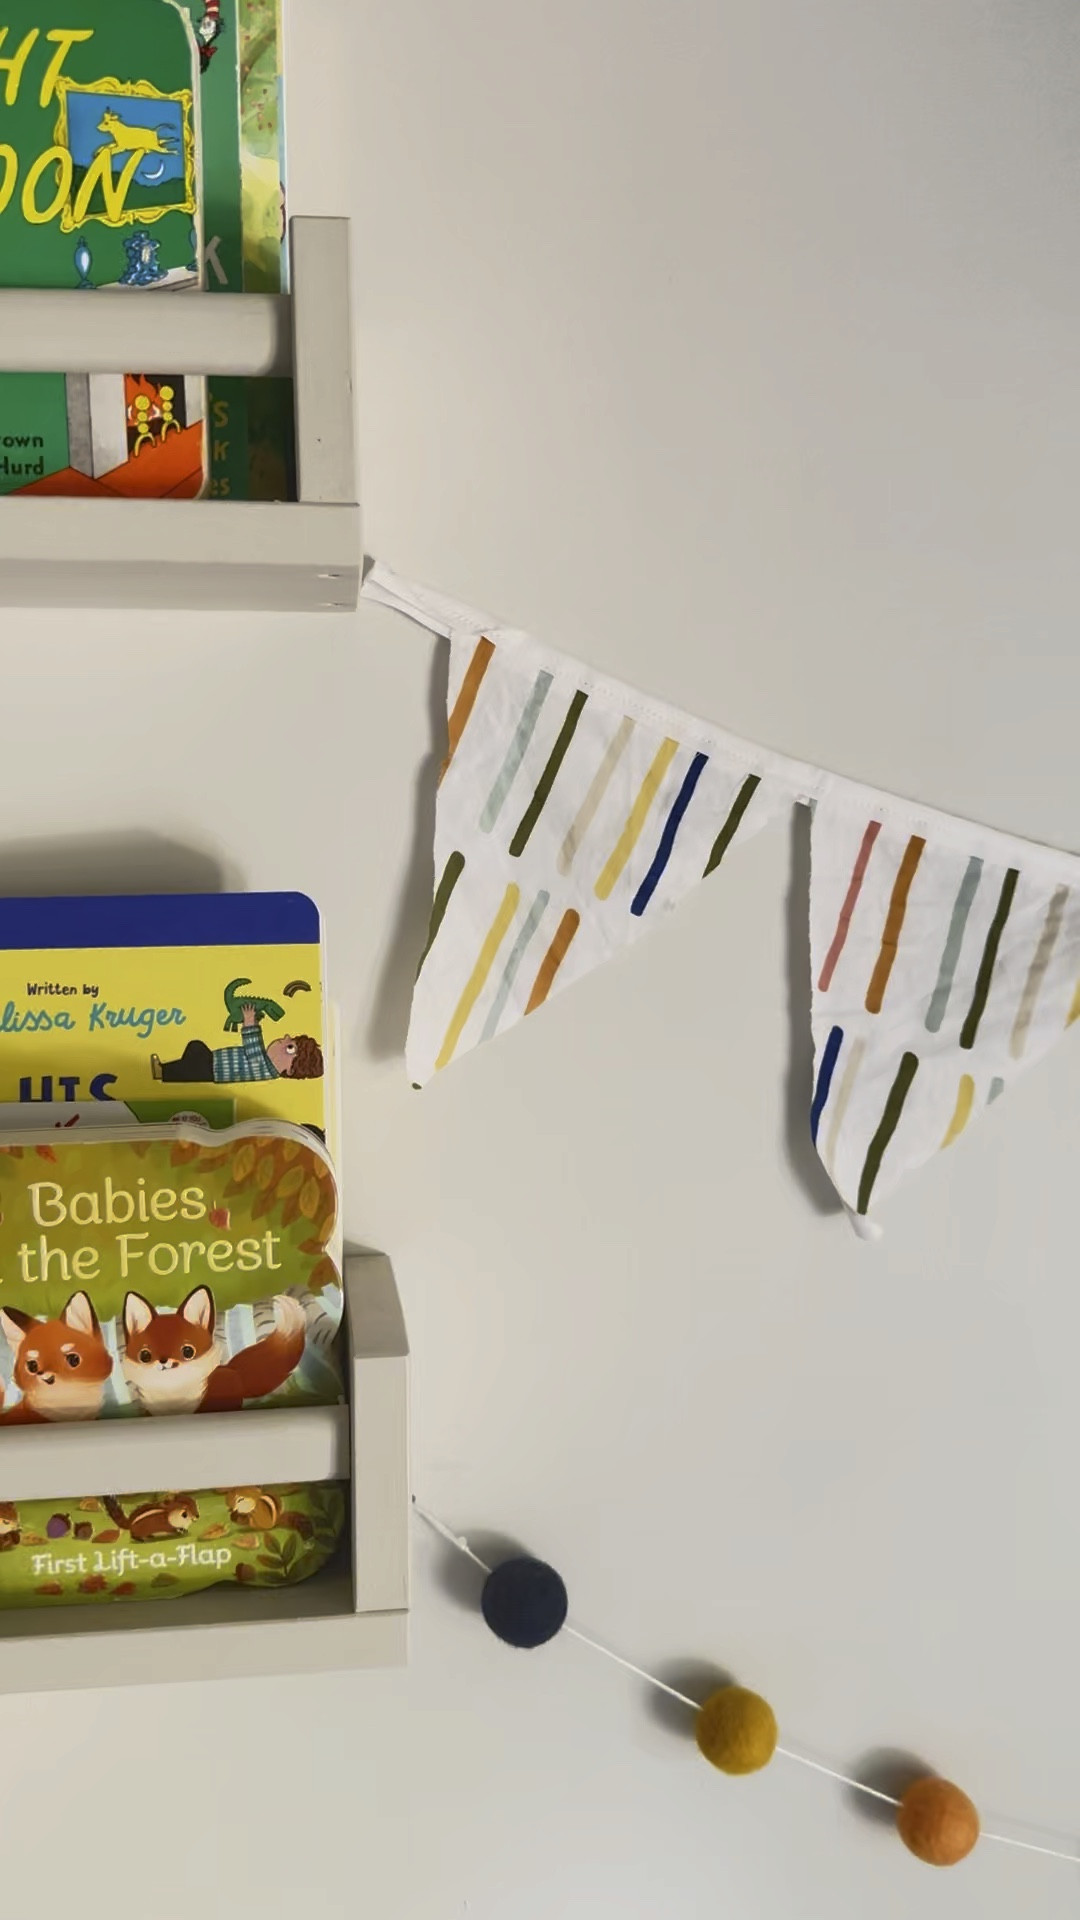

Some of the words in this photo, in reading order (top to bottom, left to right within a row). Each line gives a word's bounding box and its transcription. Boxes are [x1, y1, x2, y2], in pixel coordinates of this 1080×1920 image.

[0, 435, 44, 448] own
[27, 982, 78, 996] Written
[82, 984, 99, 998] by
[0, 1000, 76, 1032] lissa
[89, 1003, 187, 1038] Kruger
[27, 1176, 207, 1227] Babies
[17, 1234, 101, 1282] the
[115, 1230, 282, 1278] Forest
[31, 1553, 87, 1576] First
[93, 1543, 232, 1576] Lift-a-Flap
